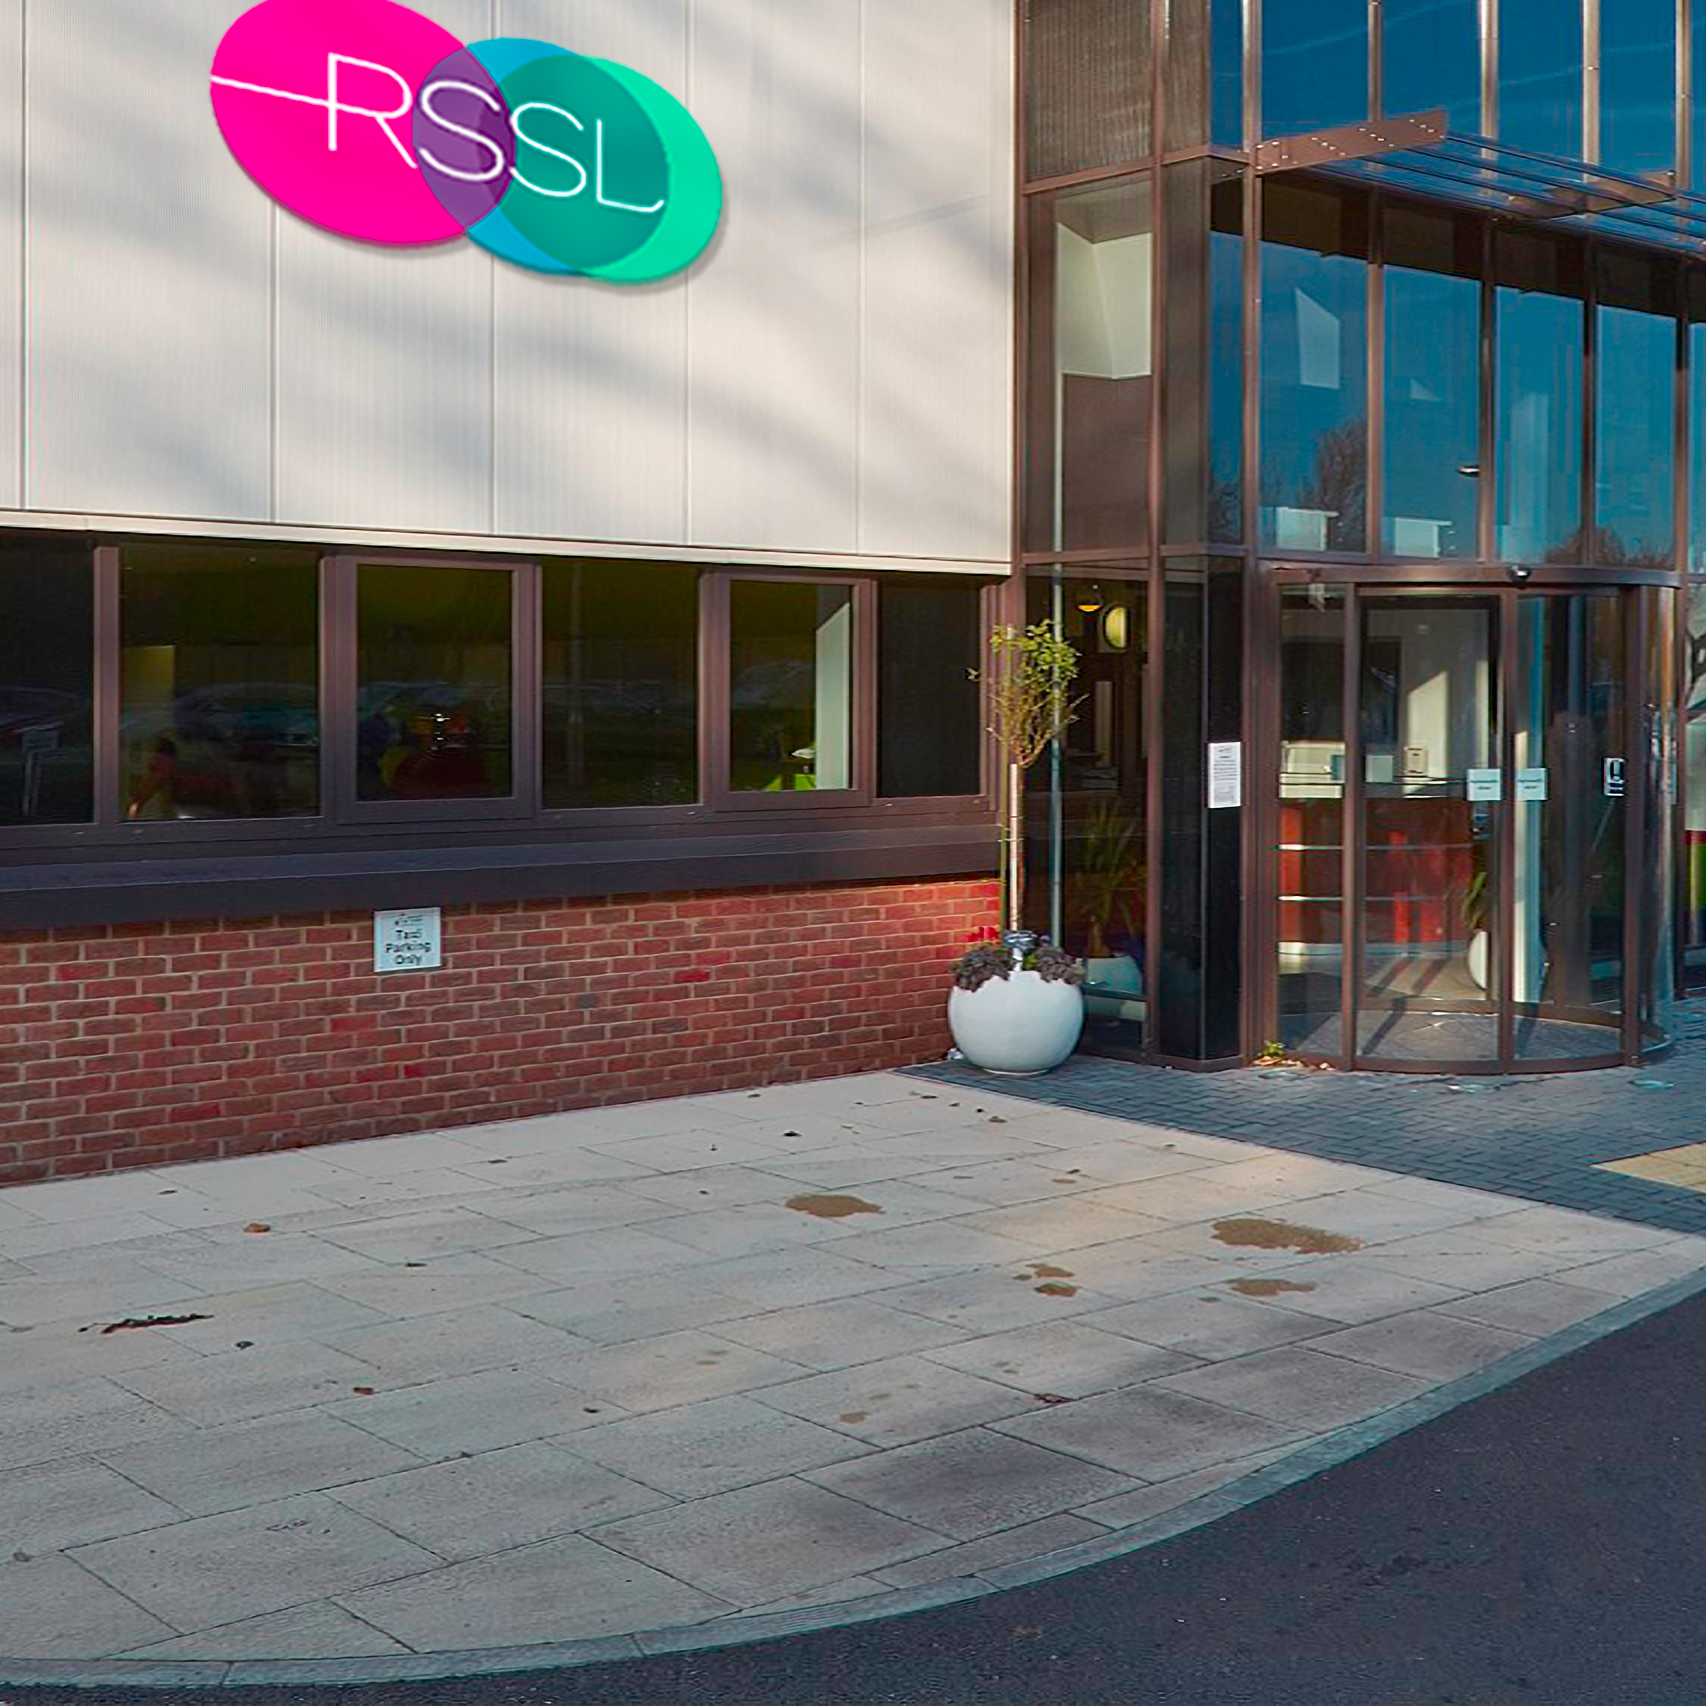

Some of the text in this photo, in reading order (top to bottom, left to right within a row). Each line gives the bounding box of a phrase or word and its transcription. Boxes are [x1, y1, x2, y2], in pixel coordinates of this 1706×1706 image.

[211, 52, 665, 213] RSSL
[385, 941, 432, 954] Parking
[394, 953, 423, 966] Only
